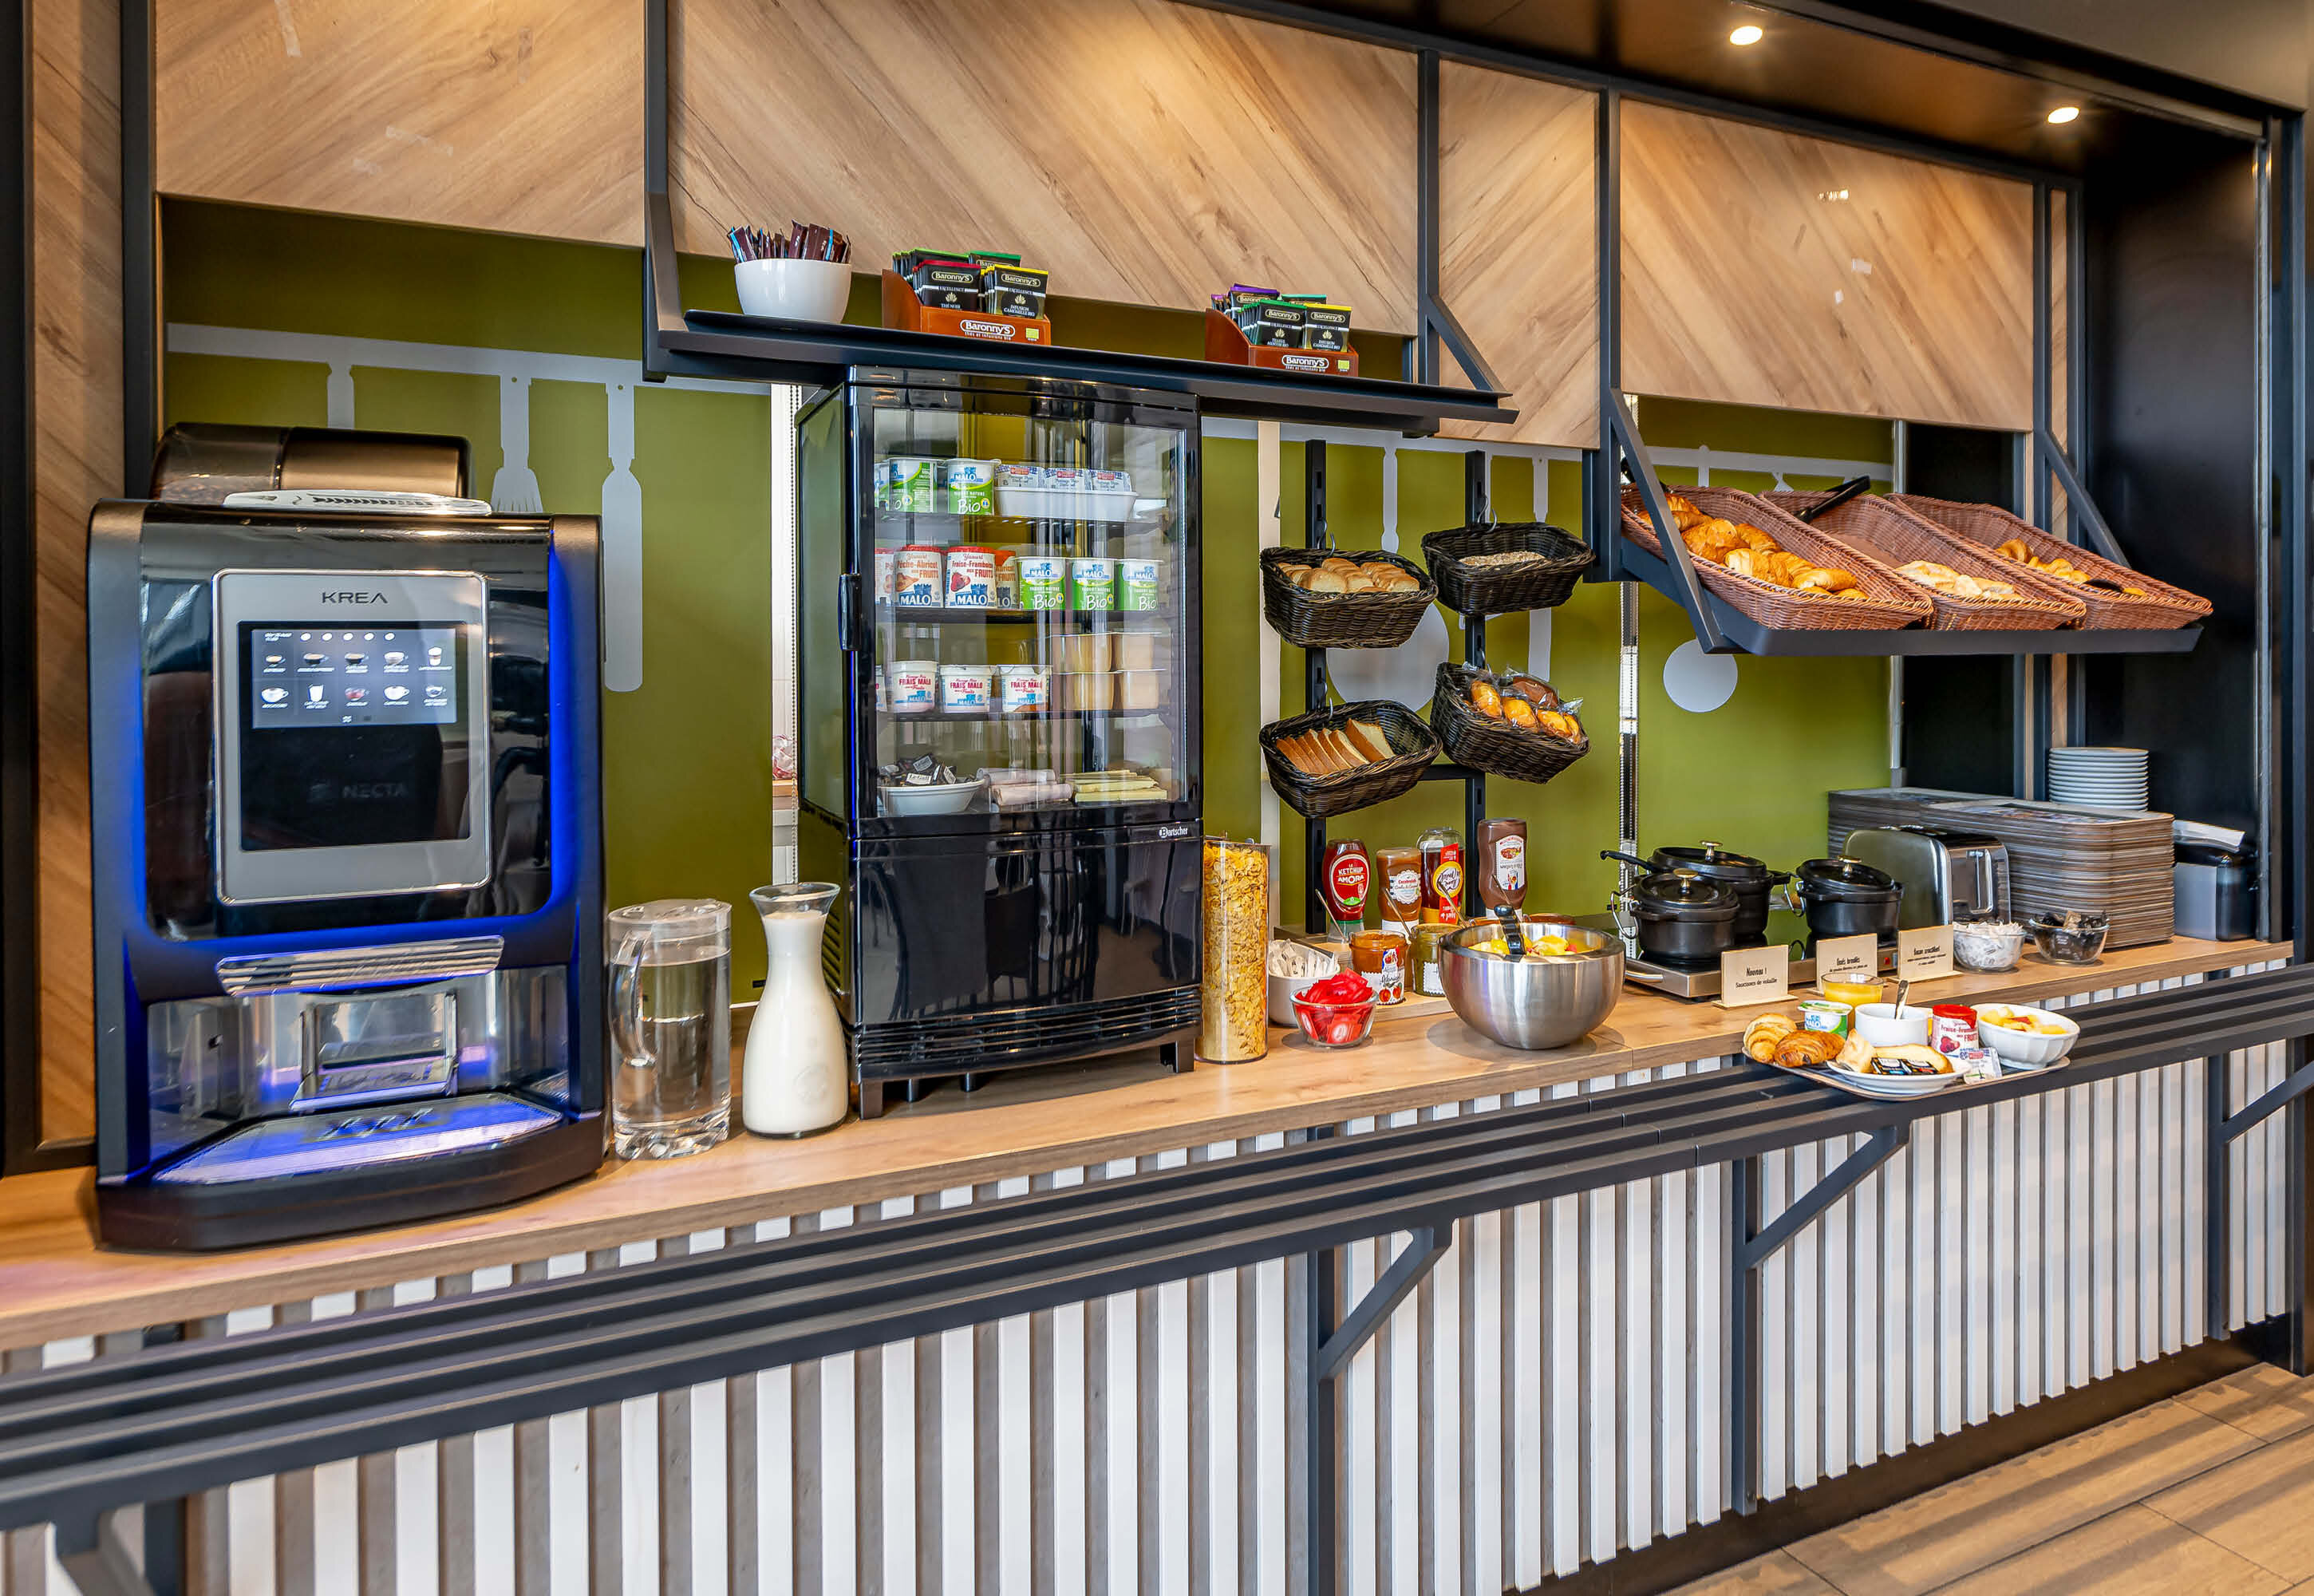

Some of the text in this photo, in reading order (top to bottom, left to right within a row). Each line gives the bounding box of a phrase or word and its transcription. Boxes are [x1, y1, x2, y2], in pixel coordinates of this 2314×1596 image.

[958, 499, 980, 514] Bio
[322, 592, 388, 603] KREA
[900, 595, 931, 606] MALO
[958, 595, 987, 606] MALO
[1034, 595, 1057, 610] Bio
[1086, 595, 1108, 610] Bio
[1139, 596, 1157, 610] Bio
[1159, 827, 1188, 838] Bartscher
[1338, 867, 1363, 875] KETCHUP
[1338, 875, 1364, 884] AMORA
